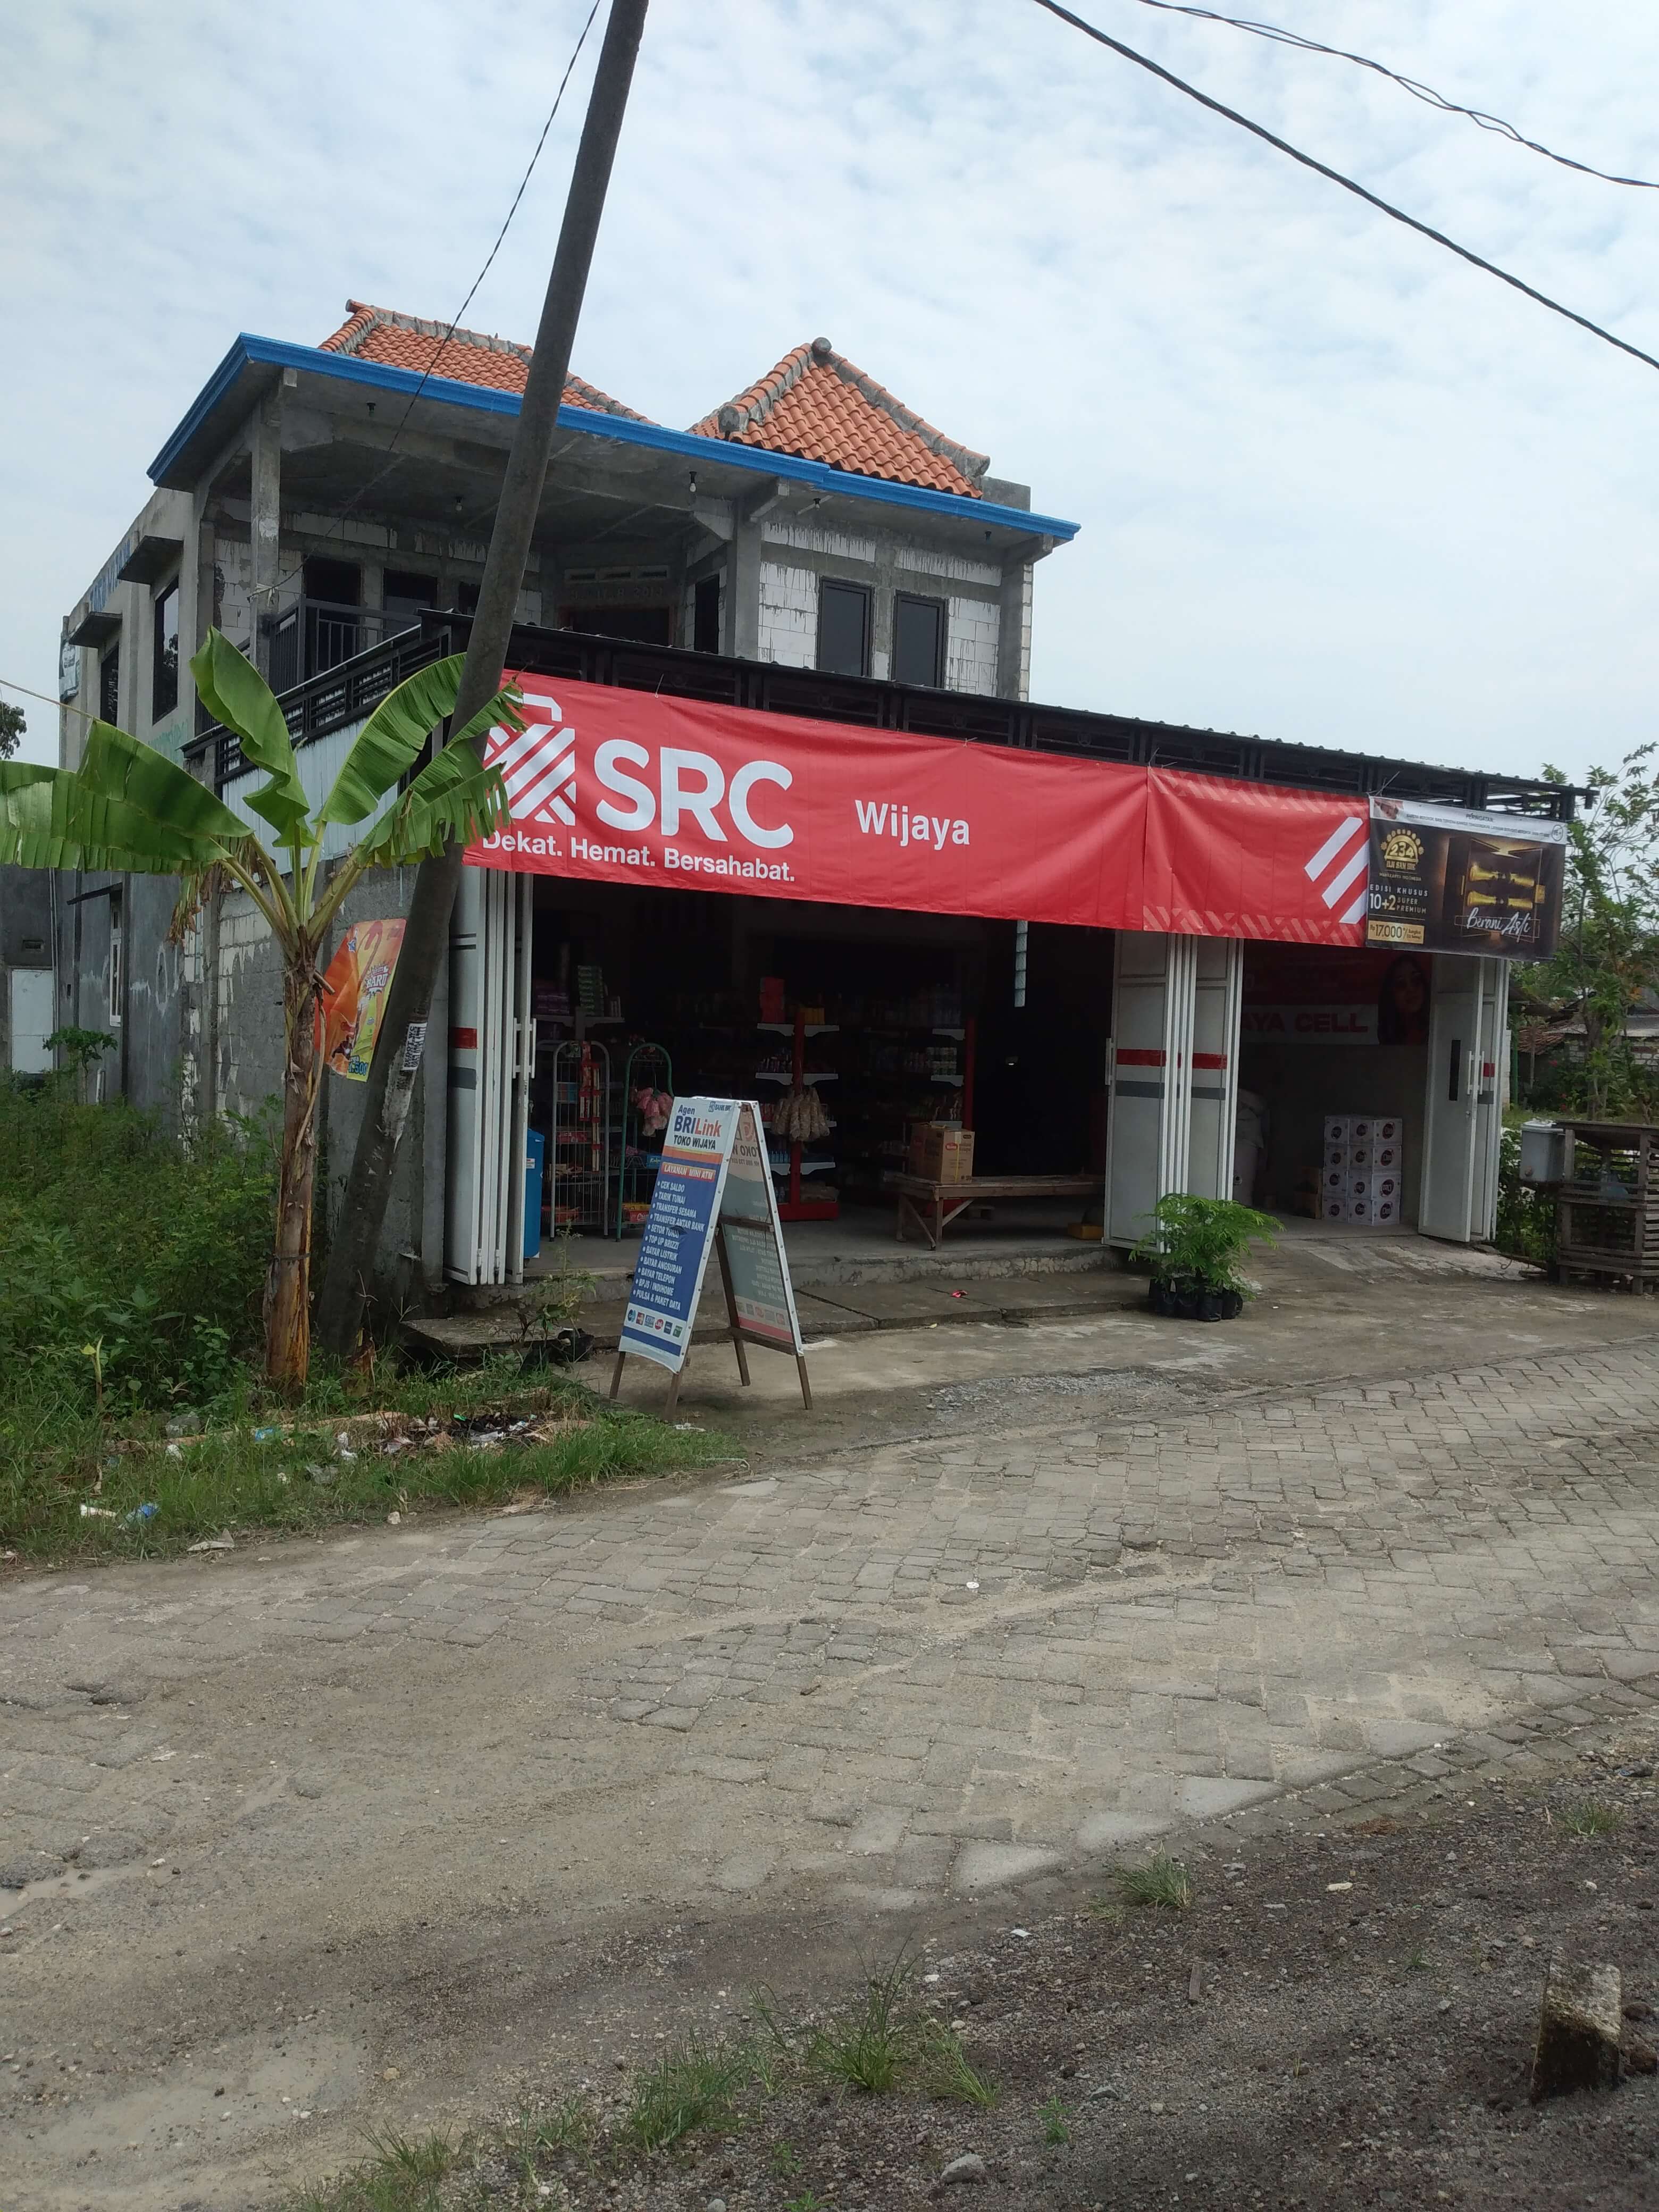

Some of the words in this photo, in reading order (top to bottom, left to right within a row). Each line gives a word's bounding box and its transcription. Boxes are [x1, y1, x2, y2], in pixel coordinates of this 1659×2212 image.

[594, 739, 794, 849] SRC
[854, 799, 970, 851] Wijaya
[482, 831, 563, 857] Dekat.
[571, 837, 656, 867] Hemat.
[664, 848, 795, 882] Bersahabat.
[1390, 842, 1414, 858] 234
[1397, 887, 1428, 896] KHUSUS
[1370, 893, 1396, 910] 10+2
[1396, 905, 1427, 914] PREMIUM
[1467, 907, 1503, 929] Berani
[1501, 911, 1531, 943] Asli
[1294, 1012, 1368, 1033] CELL
[678, 1104, 695, 1116] Agen
[674, 1116, 722, 1137] BRILink
[674, 1135, 691, 1146] TOKO
[692, 1138, 716, 1150] WIJAYA
[664, 1164, 687, 1175] LAYANAN
[689, 1169, 701, 1178] MINI
[701, 1170, 713, 1180] ATM
[660, 1181, 670, 1189] CEK
[670, 1183, 685, 1193] SALDO
[659, 1192, 672, 1202] TARIK
[672, 1194, 686, 1204] TUNAI
[656, 1202, 678, 1215] TRANSFER
[678, 1207, 697, 1219] SESAMA
[650, 1224, 665, 1234] SETOR
[653, 1213, 676, 1225] TRANSFER
[675, 1218, 691, 1229] ANTAR
[691, 1222, 705, 1232] BANK
[649, 1235, 658, 1244] TOP
[658, 1237, 664, 1246] UP
[664, 1239, 680, 1250] BRIZZI
[646, 1246, 660, 1256] BAYAR
[660, 1249, 678, 1261] LISTRIK
[643, 1256, 658, 1267] BAYAR
[658, 1260, 682, 1275] ANGSURAN
[641, 1267, 655, 1278] BAYAR
[656, 1271, 676, 1285] TELEPON
[639, 1278, 650, 1288] BPJS
[652, 1283, 674, 1296] INDIHOME
[636, 1289, 650, 1301] PULSA
[650, 1294, 654, 1302] &
[655, 1295, 669, 1306] PAKET
[669, 1301, 681, 1311] DATA
